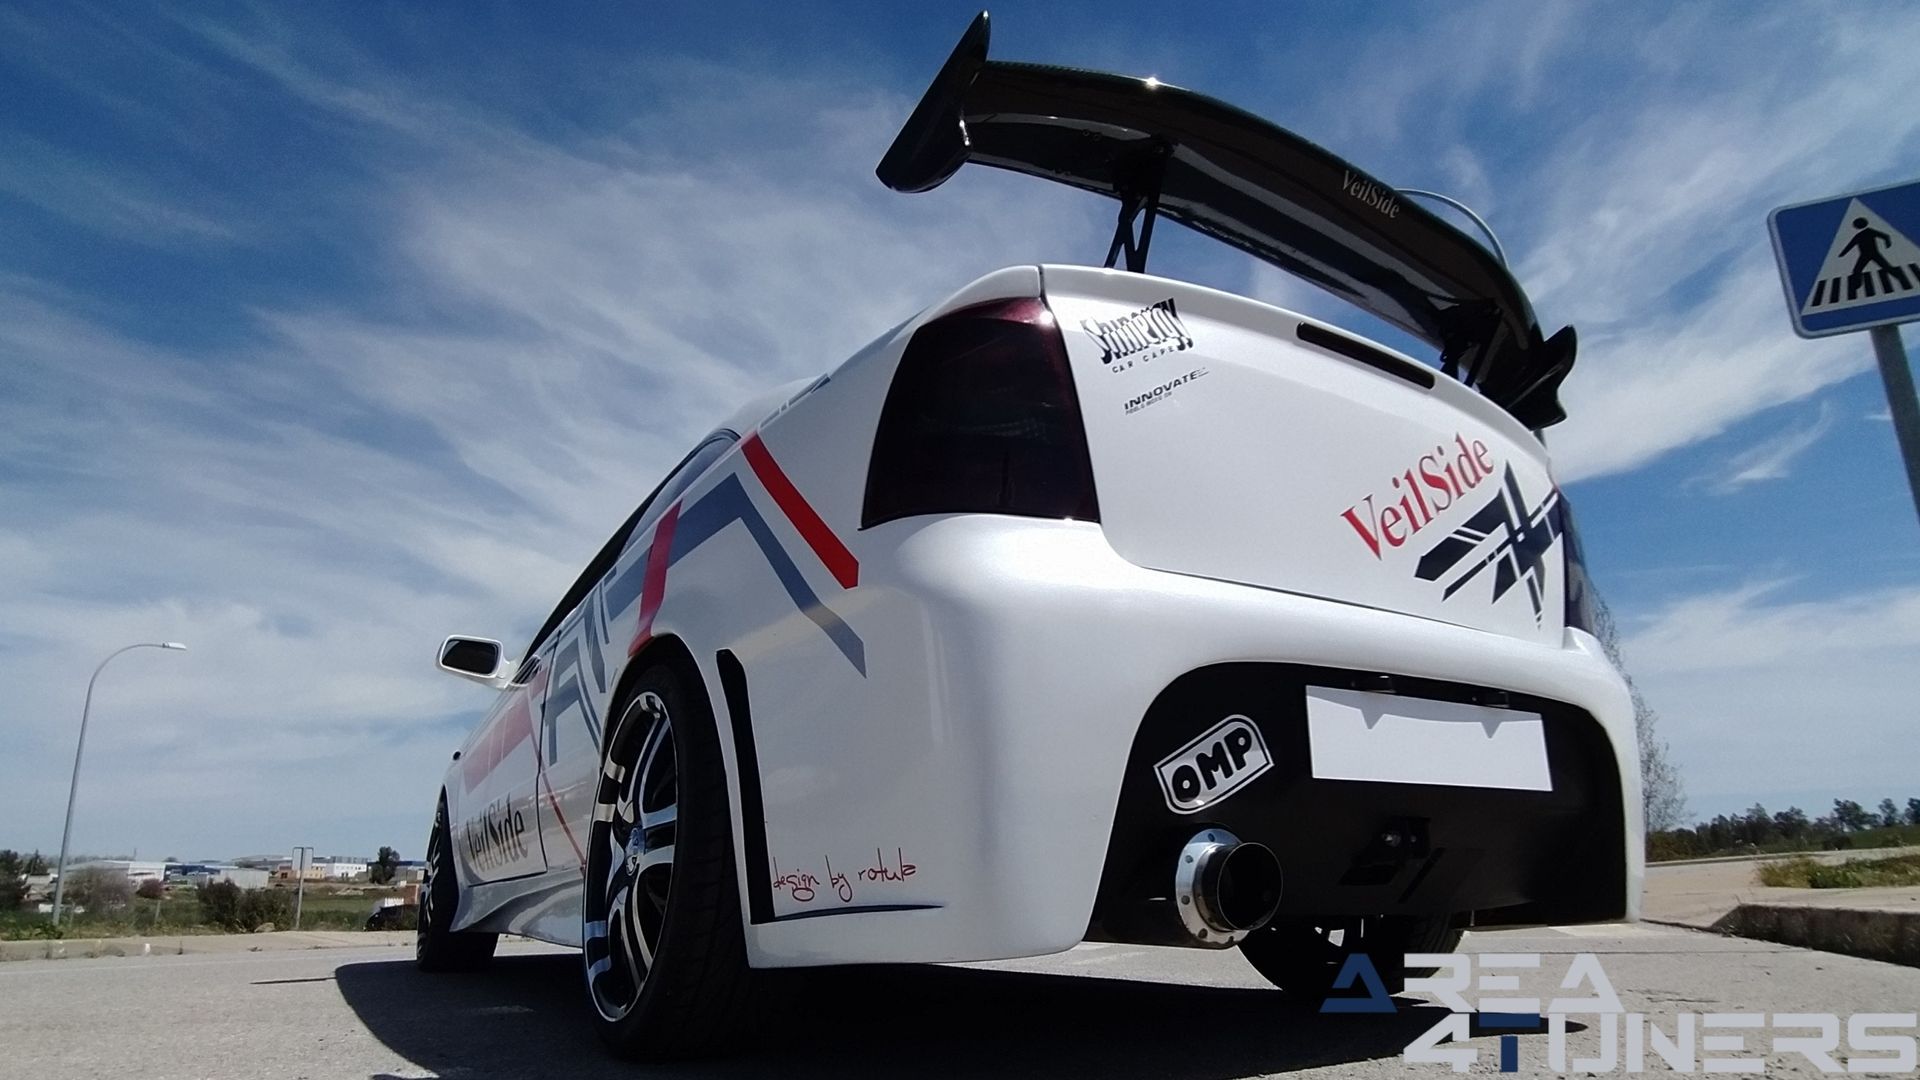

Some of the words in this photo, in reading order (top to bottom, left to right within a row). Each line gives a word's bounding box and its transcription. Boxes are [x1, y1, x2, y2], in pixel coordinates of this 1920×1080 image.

[1342, 170, 1400, 218] VeilSide
[1112, 360, 1134, 374] CAR
[1124, 368, 1204, 410] INNOVATE
[1340, 432, 1494, 561] VeilSide
[1172, 727, 1252, 803] OMP
[466, 791, 528, 872] VeilSide
[773, 856, 820, 902] design
[825, 854, 853, 903] by
